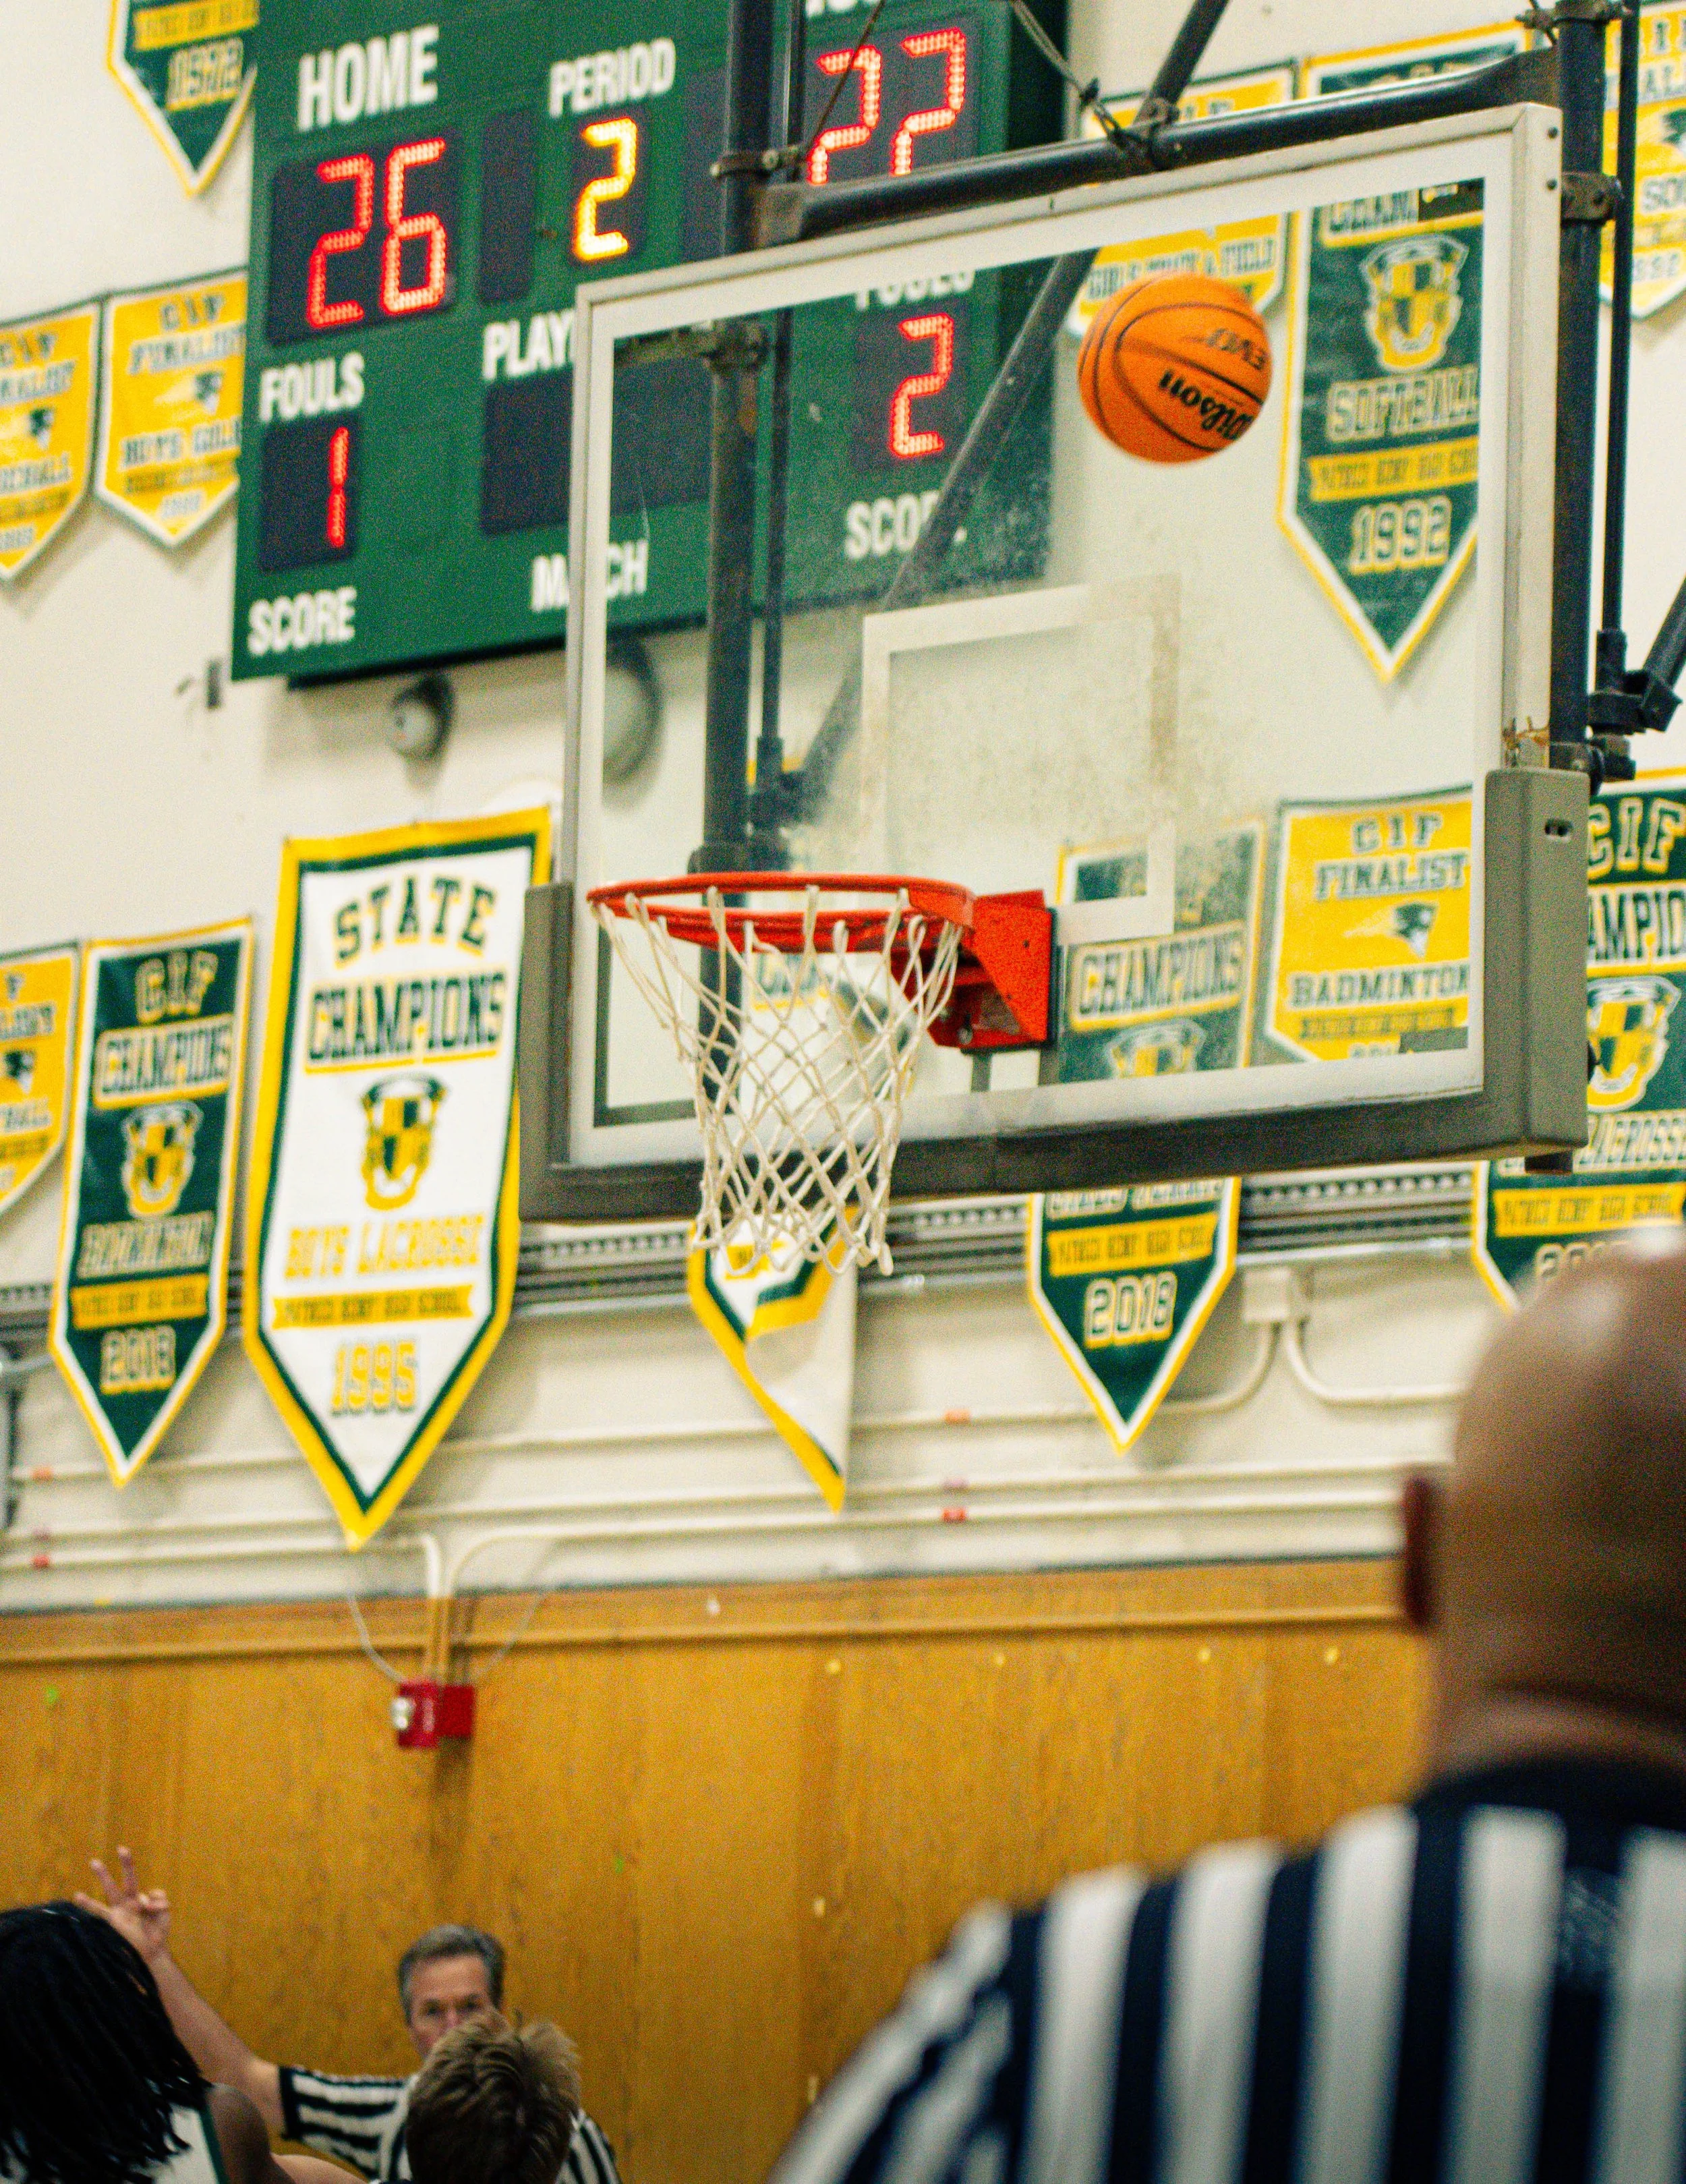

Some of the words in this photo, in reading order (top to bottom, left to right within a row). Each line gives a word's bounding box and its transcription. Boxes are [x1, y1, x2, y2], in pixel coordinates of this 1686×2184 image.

[297, 24, 440, 133] HOME
[548, 36, 676, 119] PERIOD
[573, 117, 639, 262] 2
[307, 136, 446, 330] 26
[482, 308, 576, 382] PLAY
[888, 310, 955, 460] 2
[260, 351, 365, 424] FOULS
[326, 426, 351, 550] 1
[530, 537, 649, 612] MCH
[1350, 494, 1452, 575] 1992
[247, 585, 357, 656] SCORE
[1354, 811, 1442, 854] CIF
[1588, 797, 1686, 877] CIF
[1314, 849, 1472, 902] FINALIST
[332, 875, 496, 966] STATE
[1074, 928, 1242, 1017] CHAMPIONS
[306, 969, 507, 1066] CHAMPIONS
[1084, 1270, 1178, 1349] 2018
[330, 1338, 419, 1416] 1995
